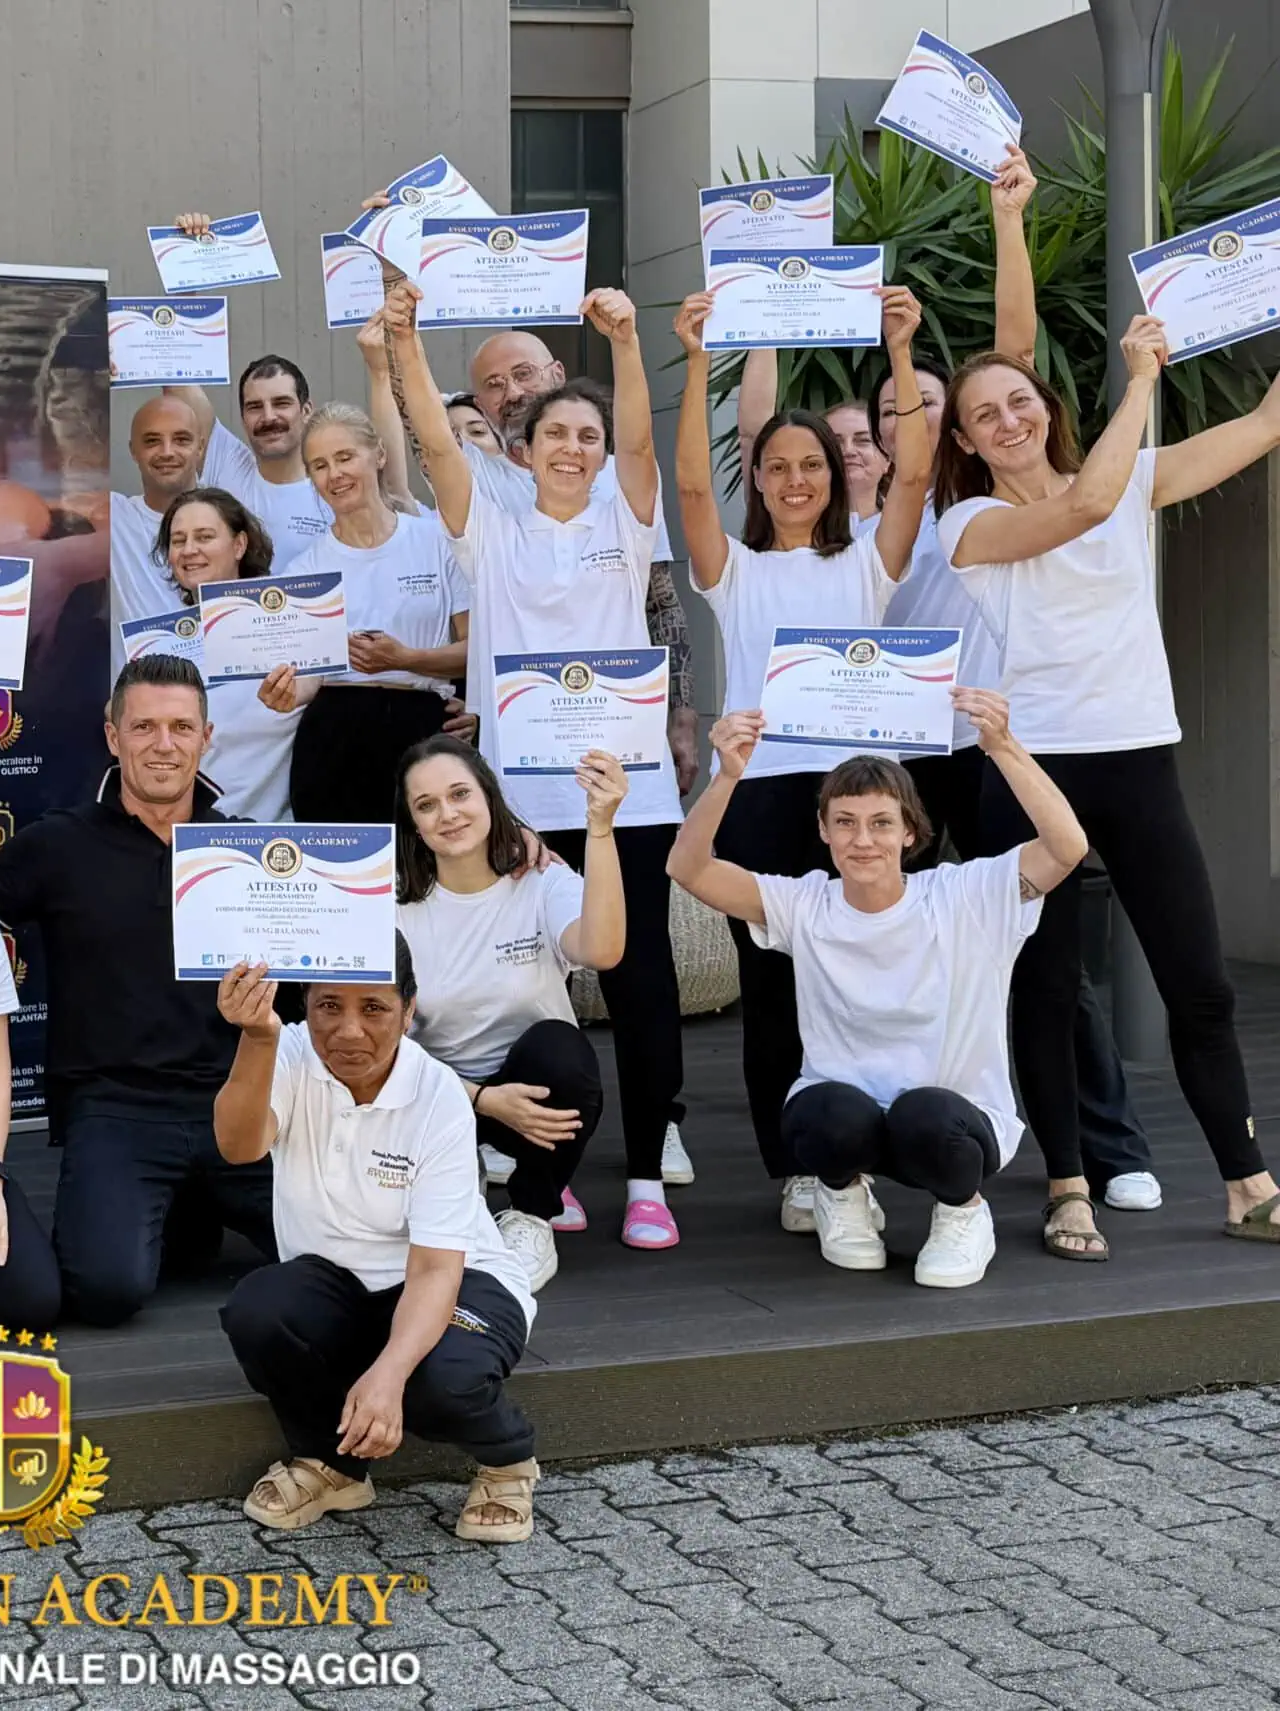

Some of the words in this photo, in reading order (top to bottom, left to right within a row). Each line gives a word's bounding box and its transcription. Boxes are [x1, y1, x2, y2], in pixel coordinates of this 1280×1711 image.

[474, 256, 528, 265] ATTESTATO
[1204, 253, 1264, 280] ATTESTATO
[252, 613, 298, 625] ATTESTATO
[520, 661, 562, 670] EVOLUTION
[830, 669, 890, 678] ATTESTATO
[550, 696, 608, 706] ATTESTATO
[34, 754, 42, 764] in
[1, 766, 38, 776] OLISTICO
[210, 838, 265, 846] EVOLUTION
[247, 882, 318, 892] ATTESTATO
